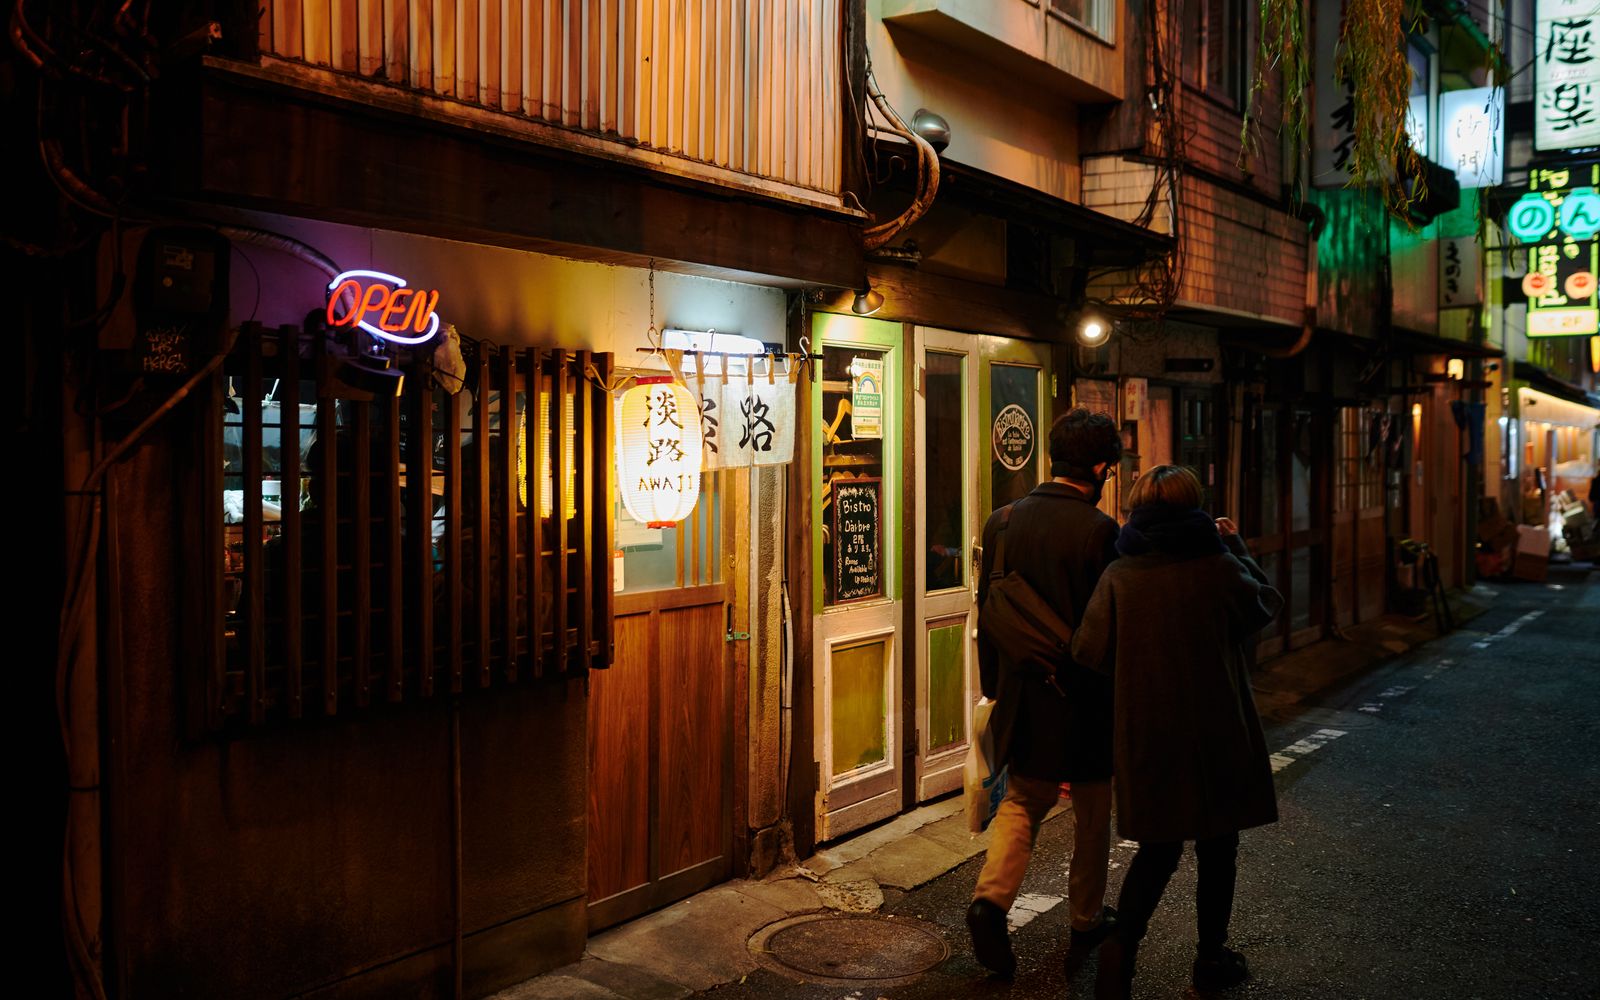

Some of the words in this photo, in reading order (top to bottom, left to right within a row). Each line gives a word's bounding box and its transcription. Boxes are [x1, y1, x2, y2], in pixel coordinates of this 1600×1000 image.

[327, 280, 439, 332] OPEN
[643, 391, 688, 466] 淡路
[639, 474, 693, 493] AWAJI
[843, 499, 871, 514] Bistro
